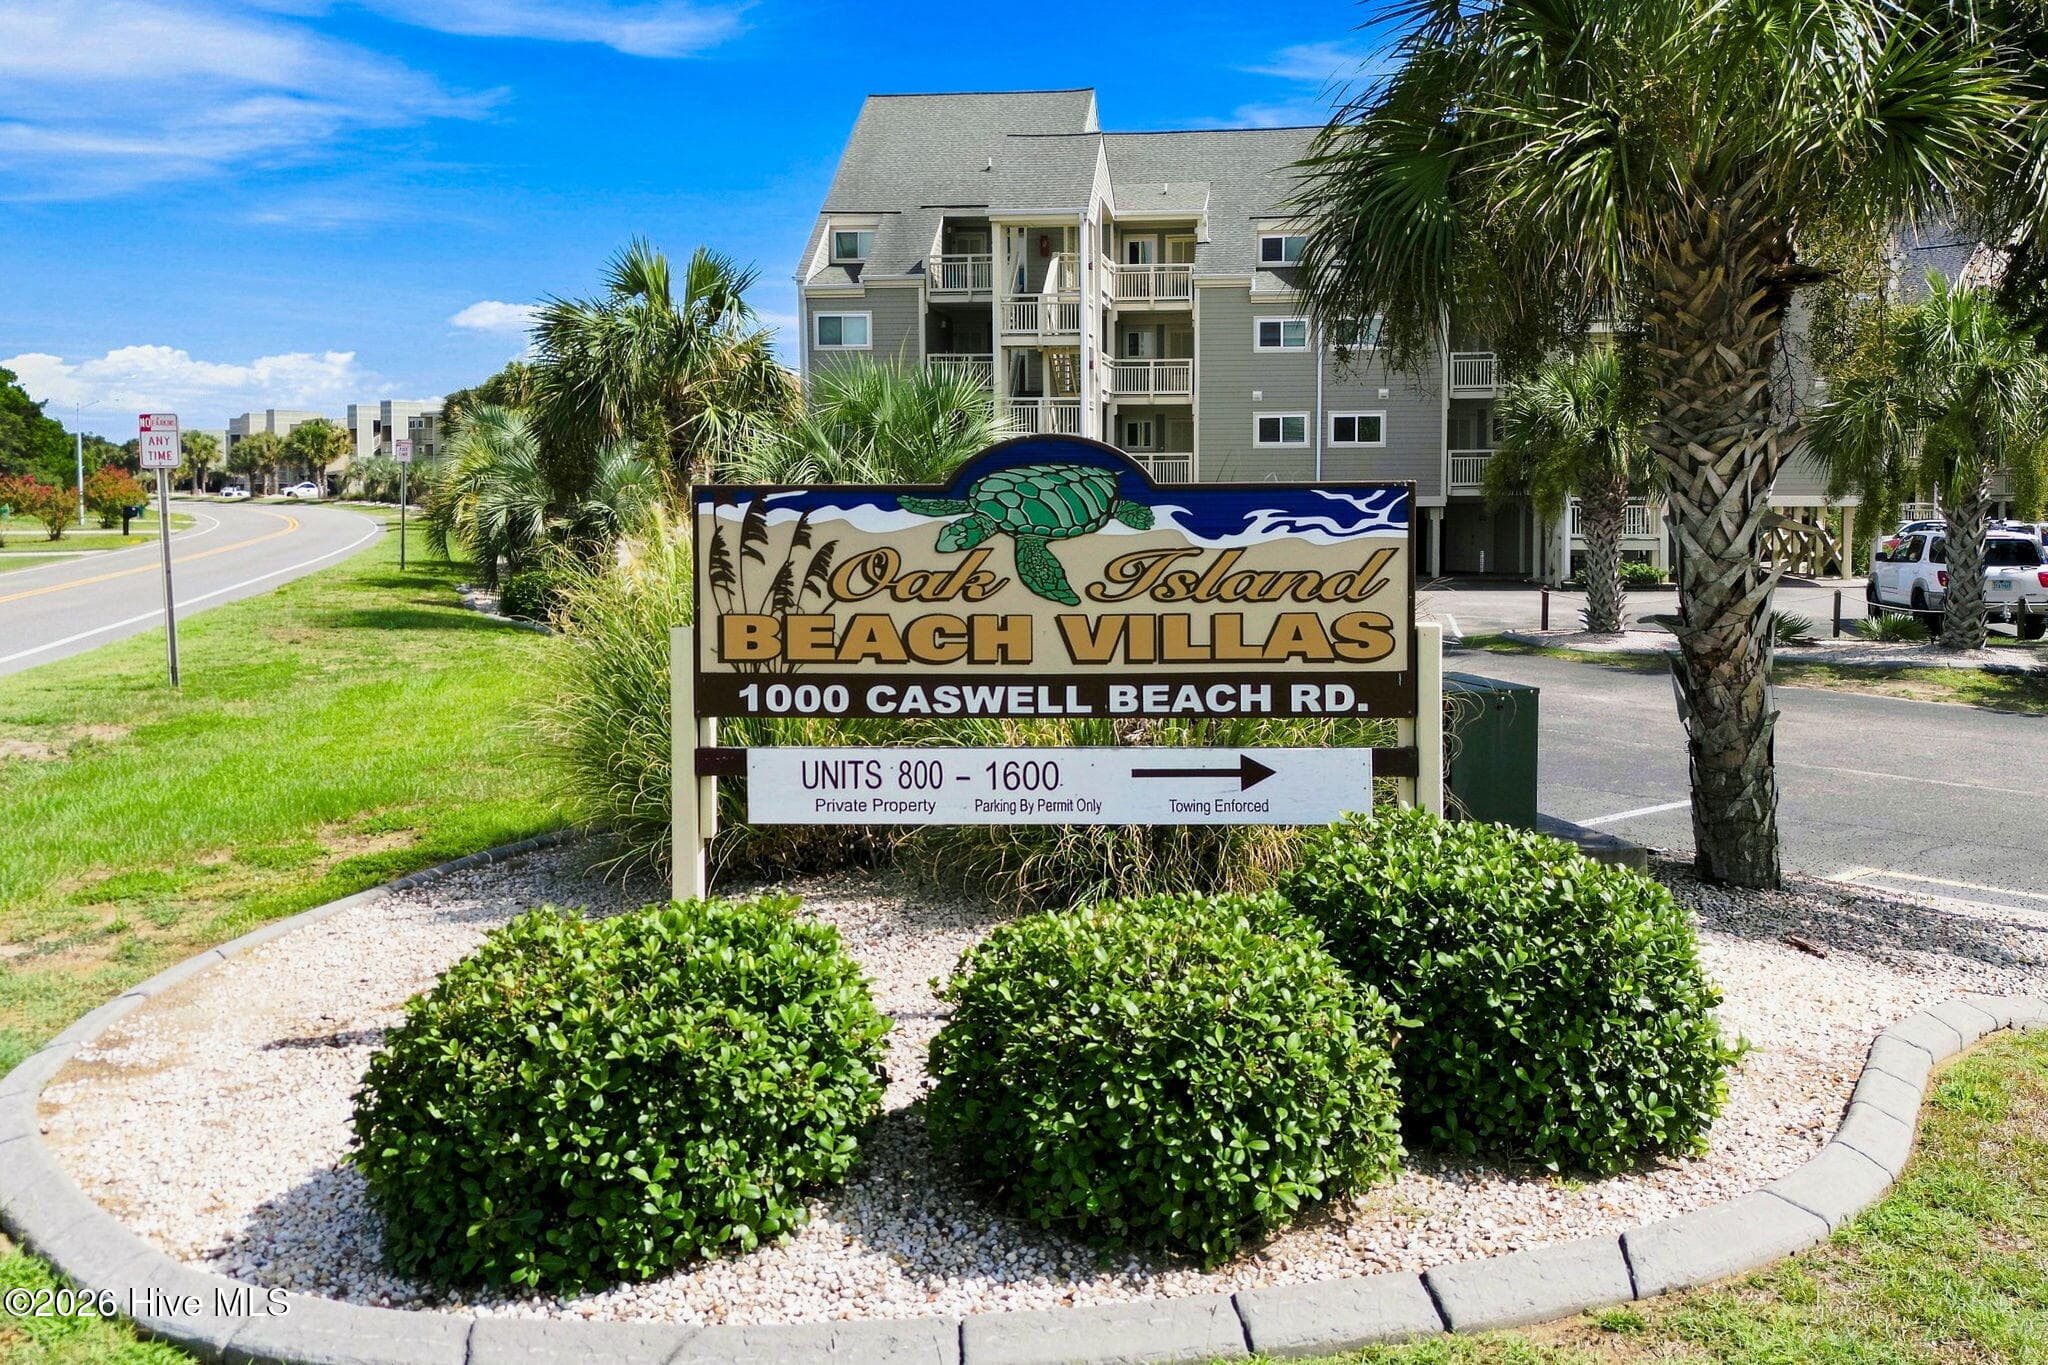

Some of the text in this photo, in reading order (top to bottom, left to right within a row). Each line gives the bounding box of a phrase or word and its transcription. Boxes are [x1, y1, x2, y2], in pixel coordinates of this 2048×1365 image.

[148, 436, 170, 446] ANY
[148, 451, 173, 461] TIME
[827, 546, 1400, 604] Oak Island
[717, 611, 1396, 665] BEACH VILLAS
[738, 683, 1369, 714] 1000 CASWELL BEACH RD.
[801, 760, 882, 790] UNITS
[899, 760, 944, 791] 800
[985, 761, 1060, 791] 1600
[815, 798, 936, 815] Private Property
[975, 798, 1102, 815] Parking By Permit Only
[1169, 799, 1269, 815] Towing Enforced
